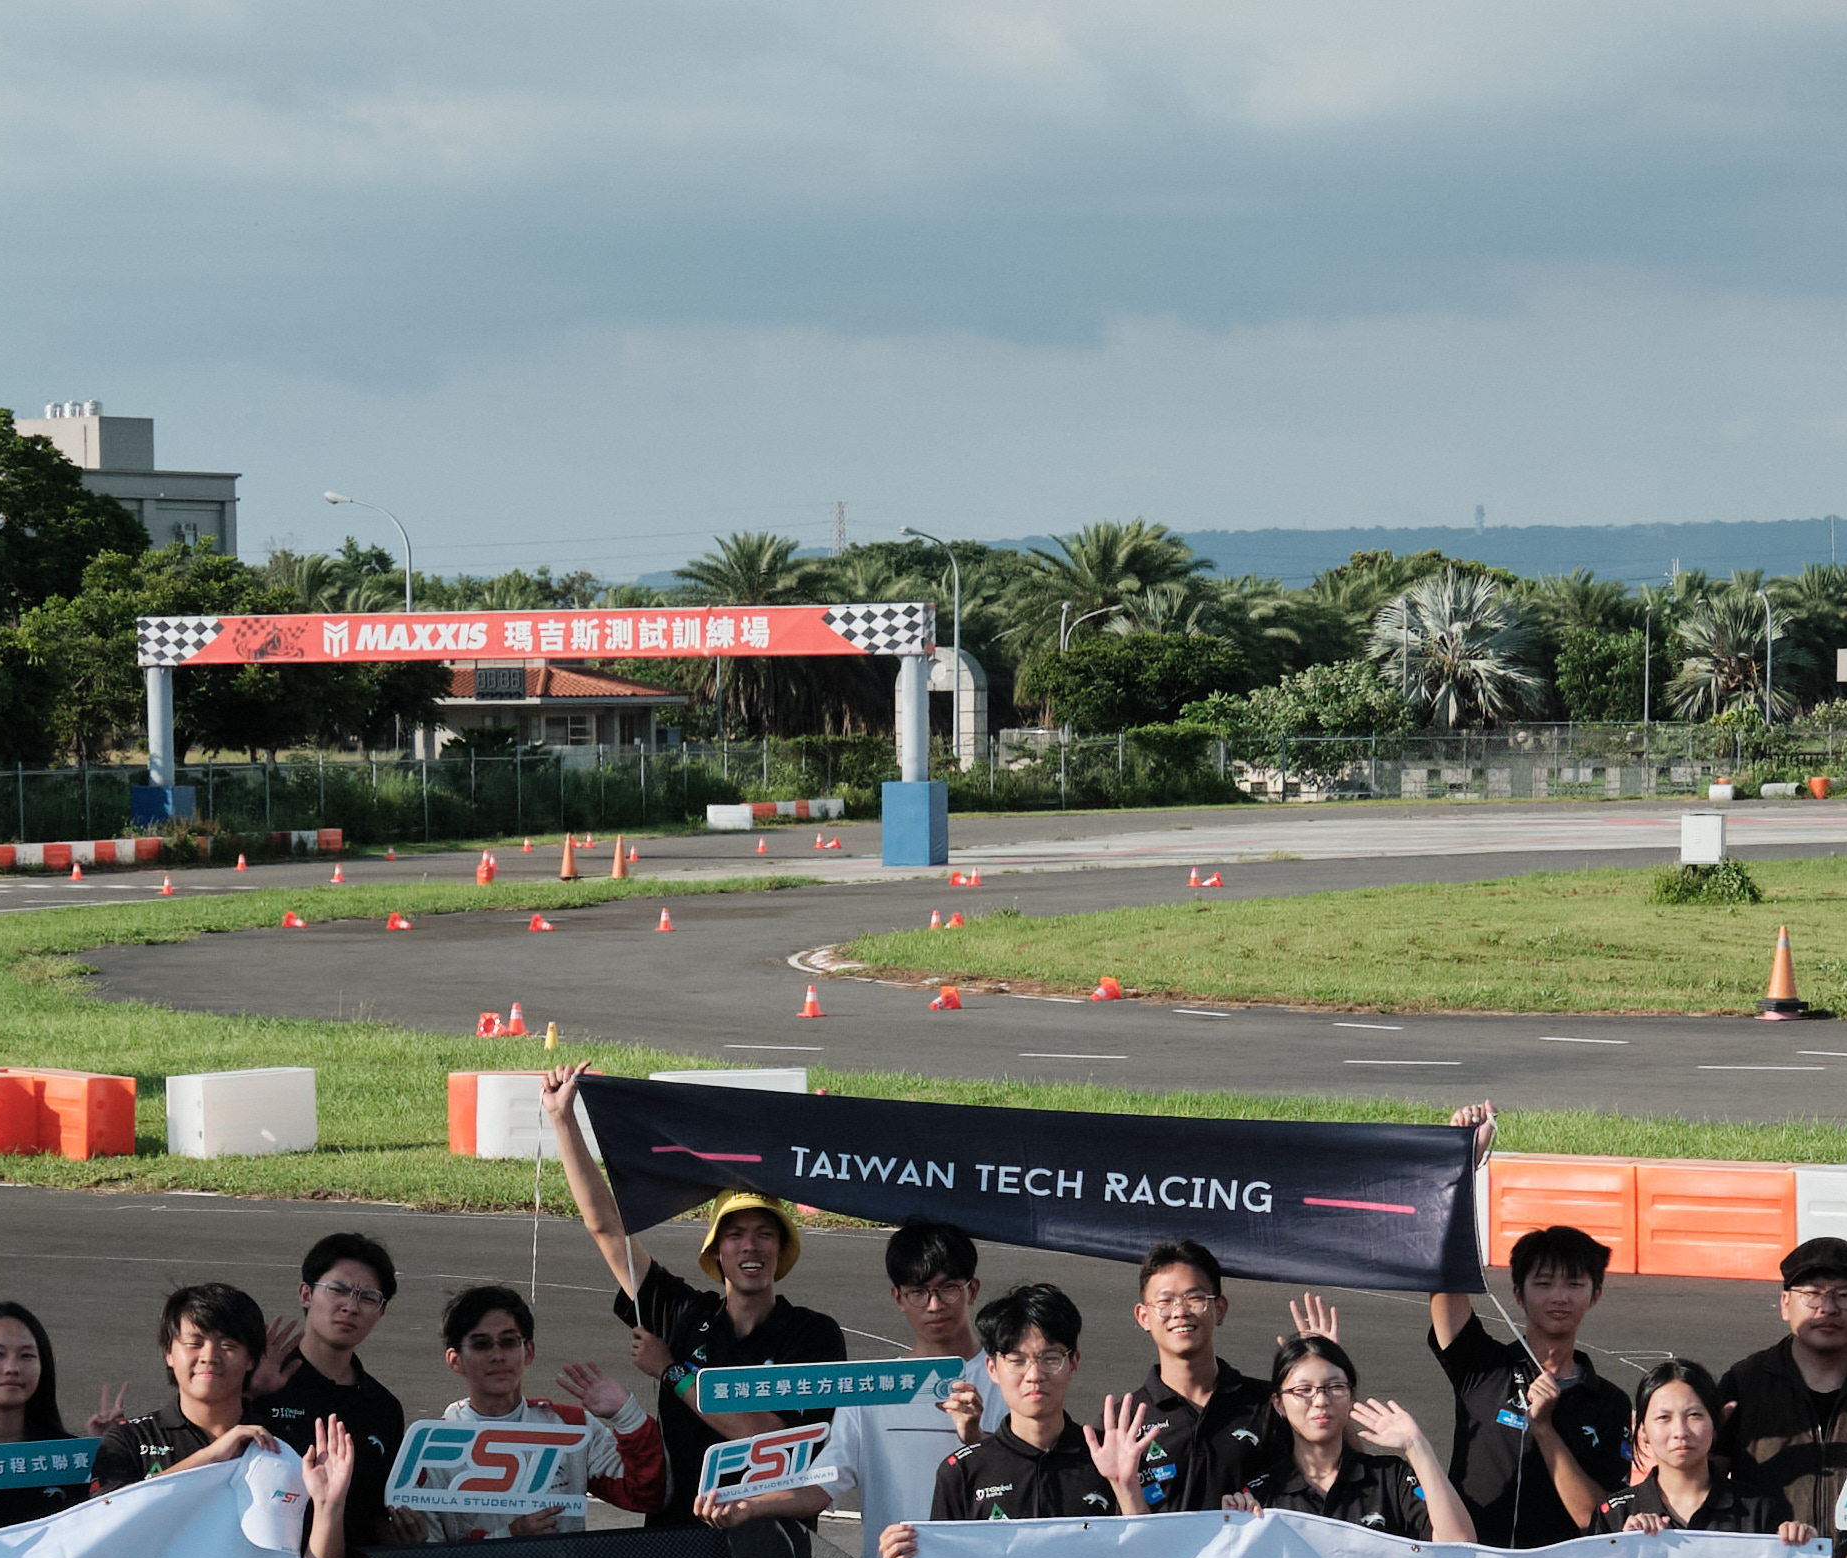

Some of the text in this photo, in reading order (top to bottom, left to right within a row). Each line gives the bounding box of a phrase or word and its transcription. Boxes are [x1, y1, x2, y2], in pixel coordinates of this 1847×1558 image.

[356, 622, 487, 651] MAXXIS
[504, 616, 770, 652] 瑪吉斯測試訓練場
[791, 1146, 1273, 1213] TAIWAN TECH RACING
[713, 1374, 916, 1399] 臺灣盃學生方程式聯賽
[394, 1428, 585, 1493] FST
[704, 1428, 825, 1492] FST
[717, 1470, 834, 1499] RMULA STUDENT TAIWAN
[393, 1495, 458, 1506] FORMULA
[464, 1498, 526, 1508] STUDENT
